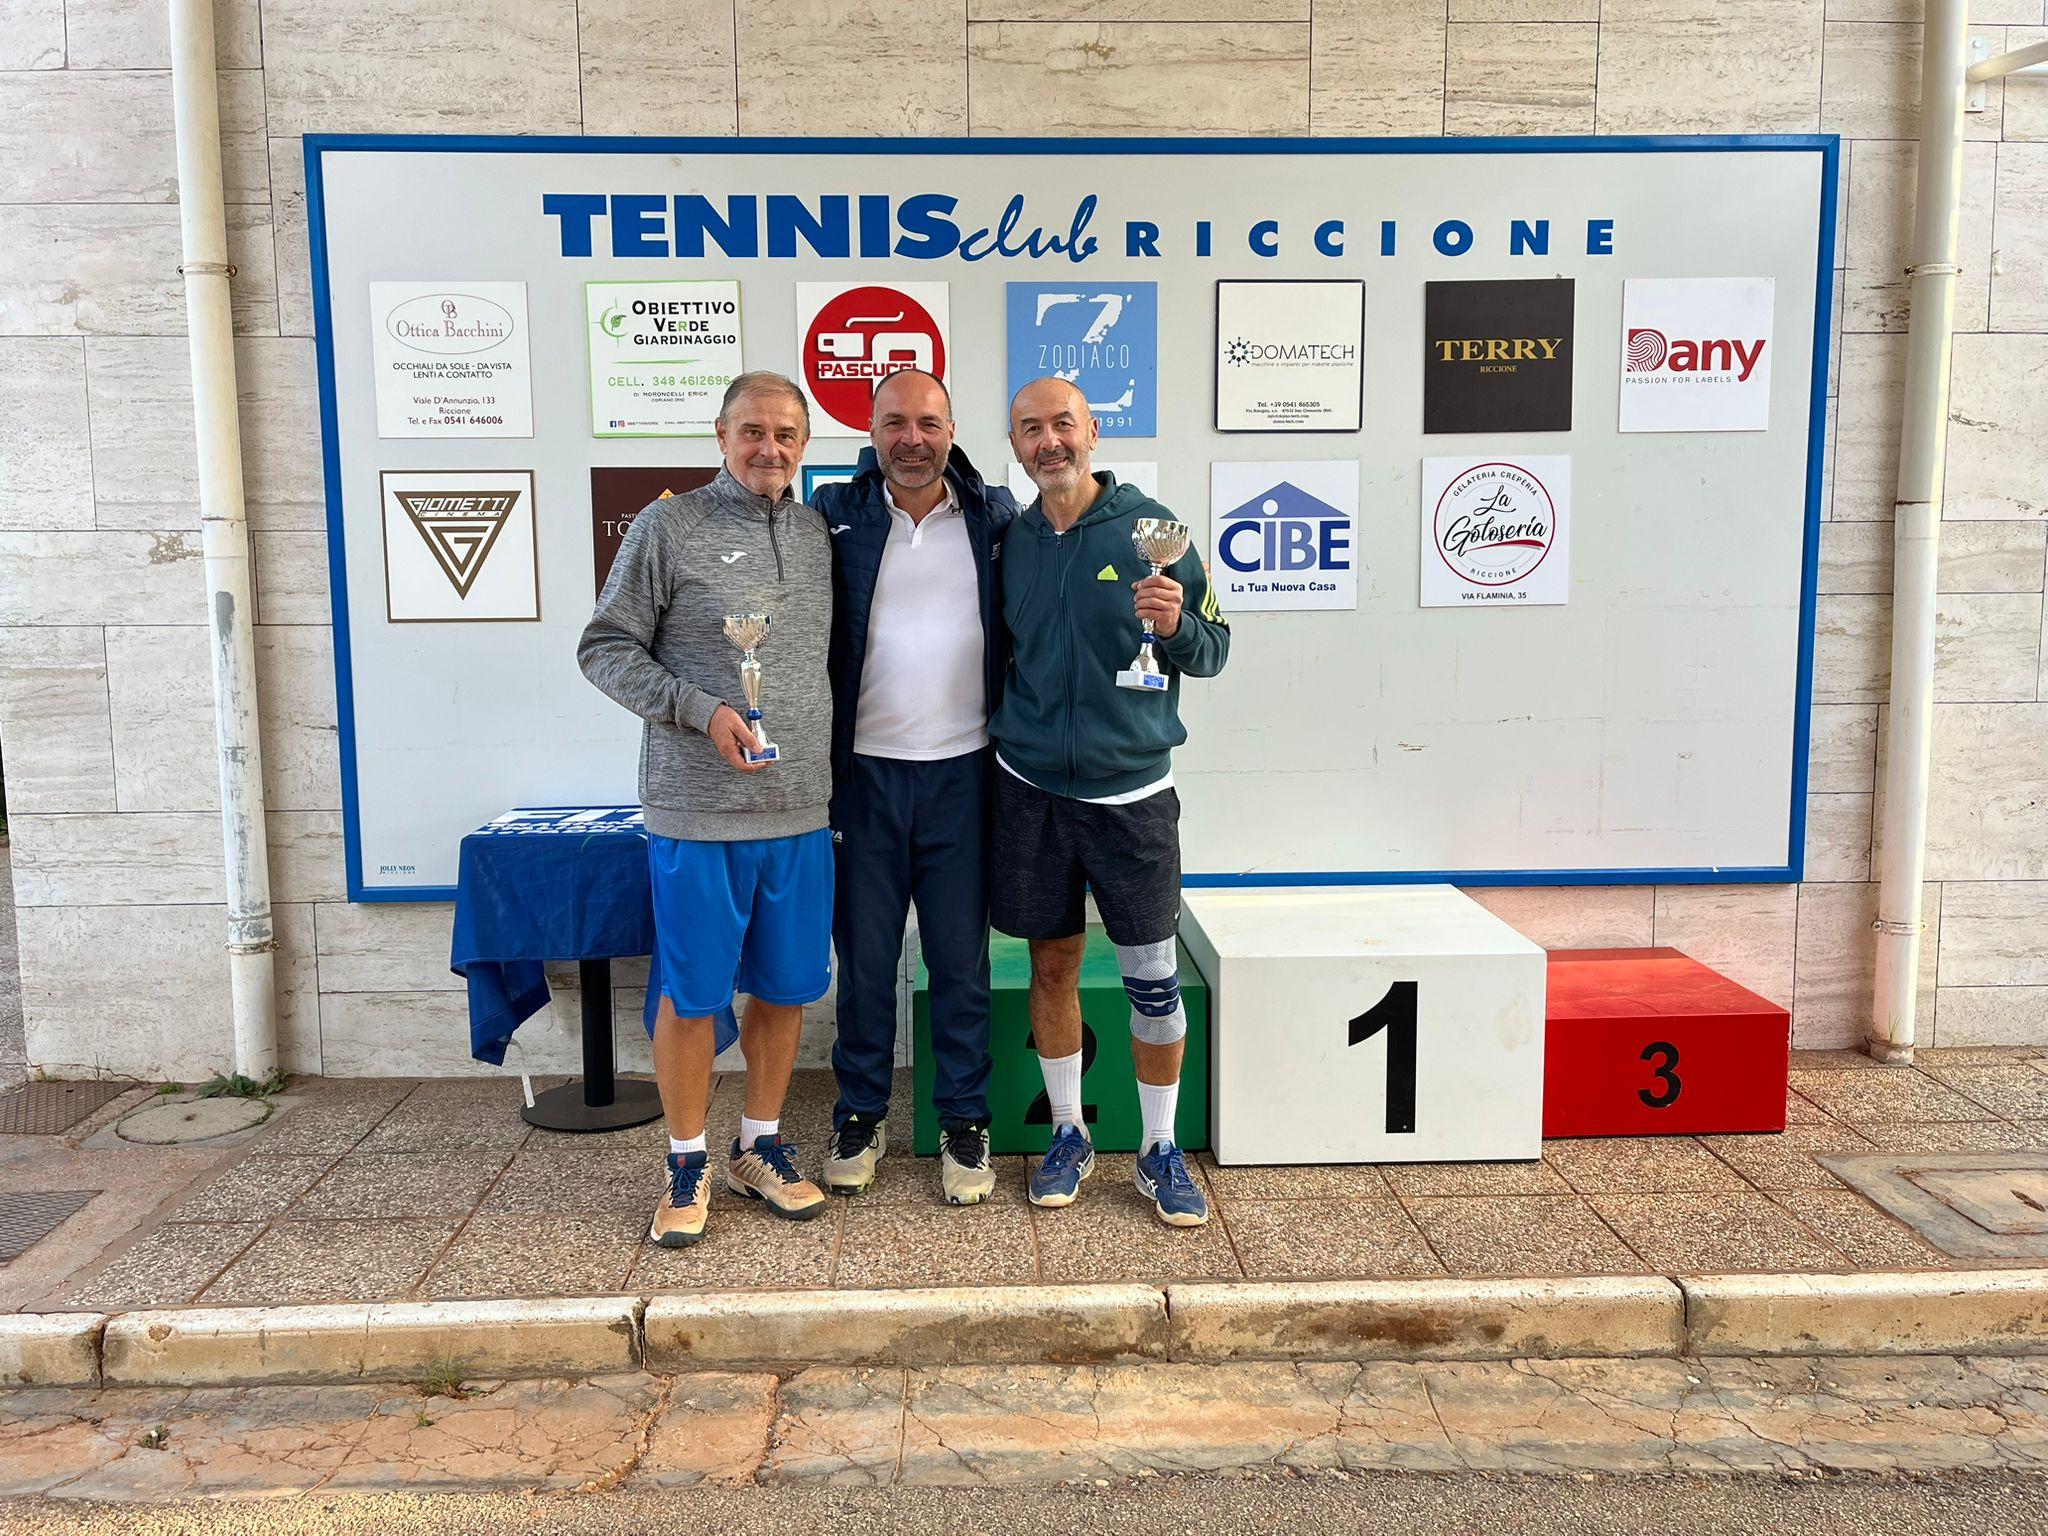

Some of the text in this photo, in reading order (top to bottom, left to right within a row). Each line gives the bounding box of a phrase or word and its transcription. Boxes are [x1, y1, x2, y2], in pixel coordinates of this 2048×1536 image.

[542, 193, 1614, 263] TENNIS club RICCIONE
[632, 300, 736, 315] OBIETTIVO
[396, 320, 504, 338] Ottica Bacchini
[653, 318, 710, 332] VERDE
[634, 334, 736, 346] GIARDINAGGIO
[1038, 344, 1130, 368] ZODIACO
[1251, 344, 1354, 360] DOMATECH
[1435, 338, 1563, 361] TERRY
[1626, 328, 1766, 382] Dany
[392, 362, 434, 370] OCCHIALI
[435, 362, 448, 370] DA
[450, 362, 470, 370] SOLE
[477, 362, 490, 370] DA
[490, 362, 512, 370] VISTA
[1480, 365, 1517, 373] RICCIONE
[413, 371, 437, 379] LENTI
[608, 376, 731, 387] CELL. 348 4612696
[412, 396, 432, 404] Viale
[482, 396, 496, 404] 133
[438, 406, 472, 414] Riccione
[408, 417, 420, 425] Tel.
[429, 417, 442, 425] Fax
[444, 416, 466, 425] 0541
[469, 416, 503, 425] 646006
[1099, 416, 1132, 427] 1991
[1453, 471, 1496, 497] GELATERIA
[406, 497, 511, 516] GIOMETTI
[1473, 485, 1516, 516] La
[1218, 520, 1350, 572] CIBE
[1470, 568, 1517, 578] RICCIONE
[1231, 582, 1336, 592] La Tua Nuova Casa
[1476, 592, 1516, 600] FLAMINIA,
[1348, 980, 1418, 1134] 1
[1637, 1041, 1682, 1109] 3
